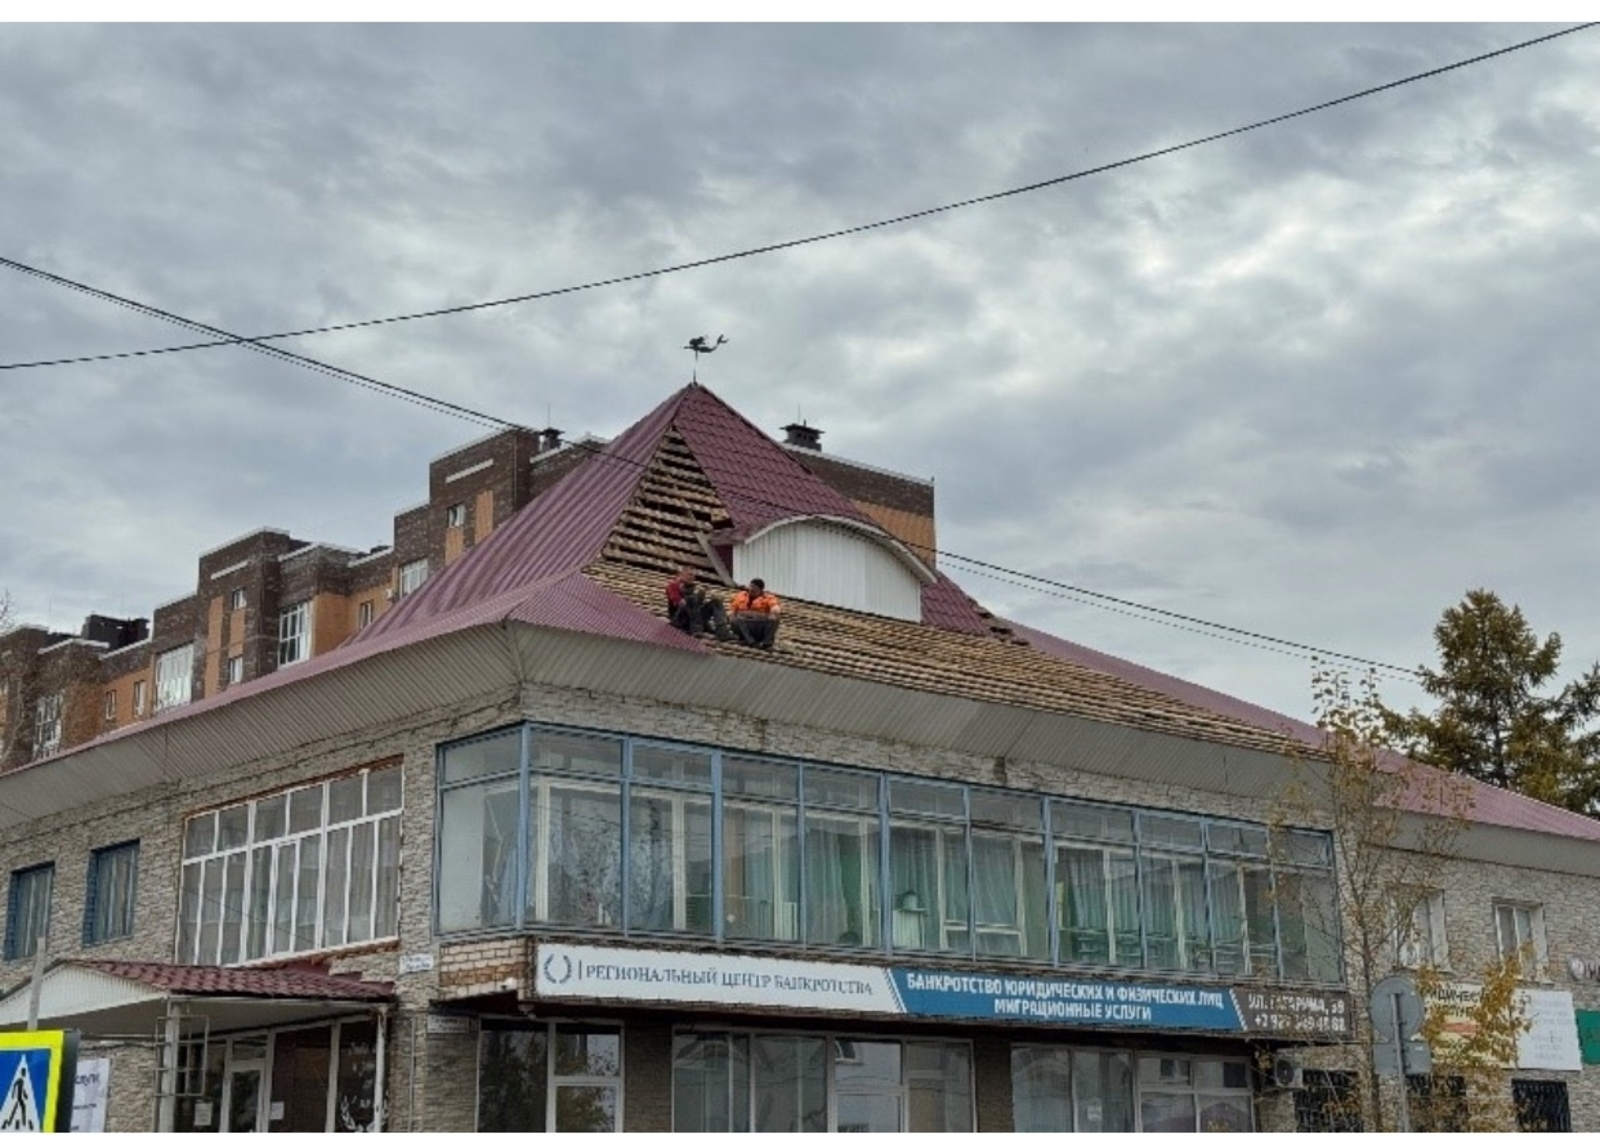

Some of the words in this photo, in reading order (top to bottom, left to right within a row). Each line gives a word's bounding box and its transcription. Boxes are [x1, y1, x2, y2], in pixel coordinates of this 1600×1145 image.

[586, 965, 718, 985] РЕГИОНАЛЬНЫЙ
[722, 972, 771, 988] ЦЕНТР
[774, 974, 874, 995] БАНКРОТСТВА
[906, 972, 1002, 994] БАНКРОТСТВО
[1004, 979, 1104, 1000] ЮРИДИЧЕСКИХ
[1105, 985, 1115, 1001] И
[1116, 986, 1197, 1006] ФИЗИЧЕСКИХ
[1198, 990, 1224, 1009] ЛИЦ
[994, 998, 1103, 1018] МИГРАЦИОННЫЕ
[1104, 1004, 1152, 1021] УСЛУГИ
